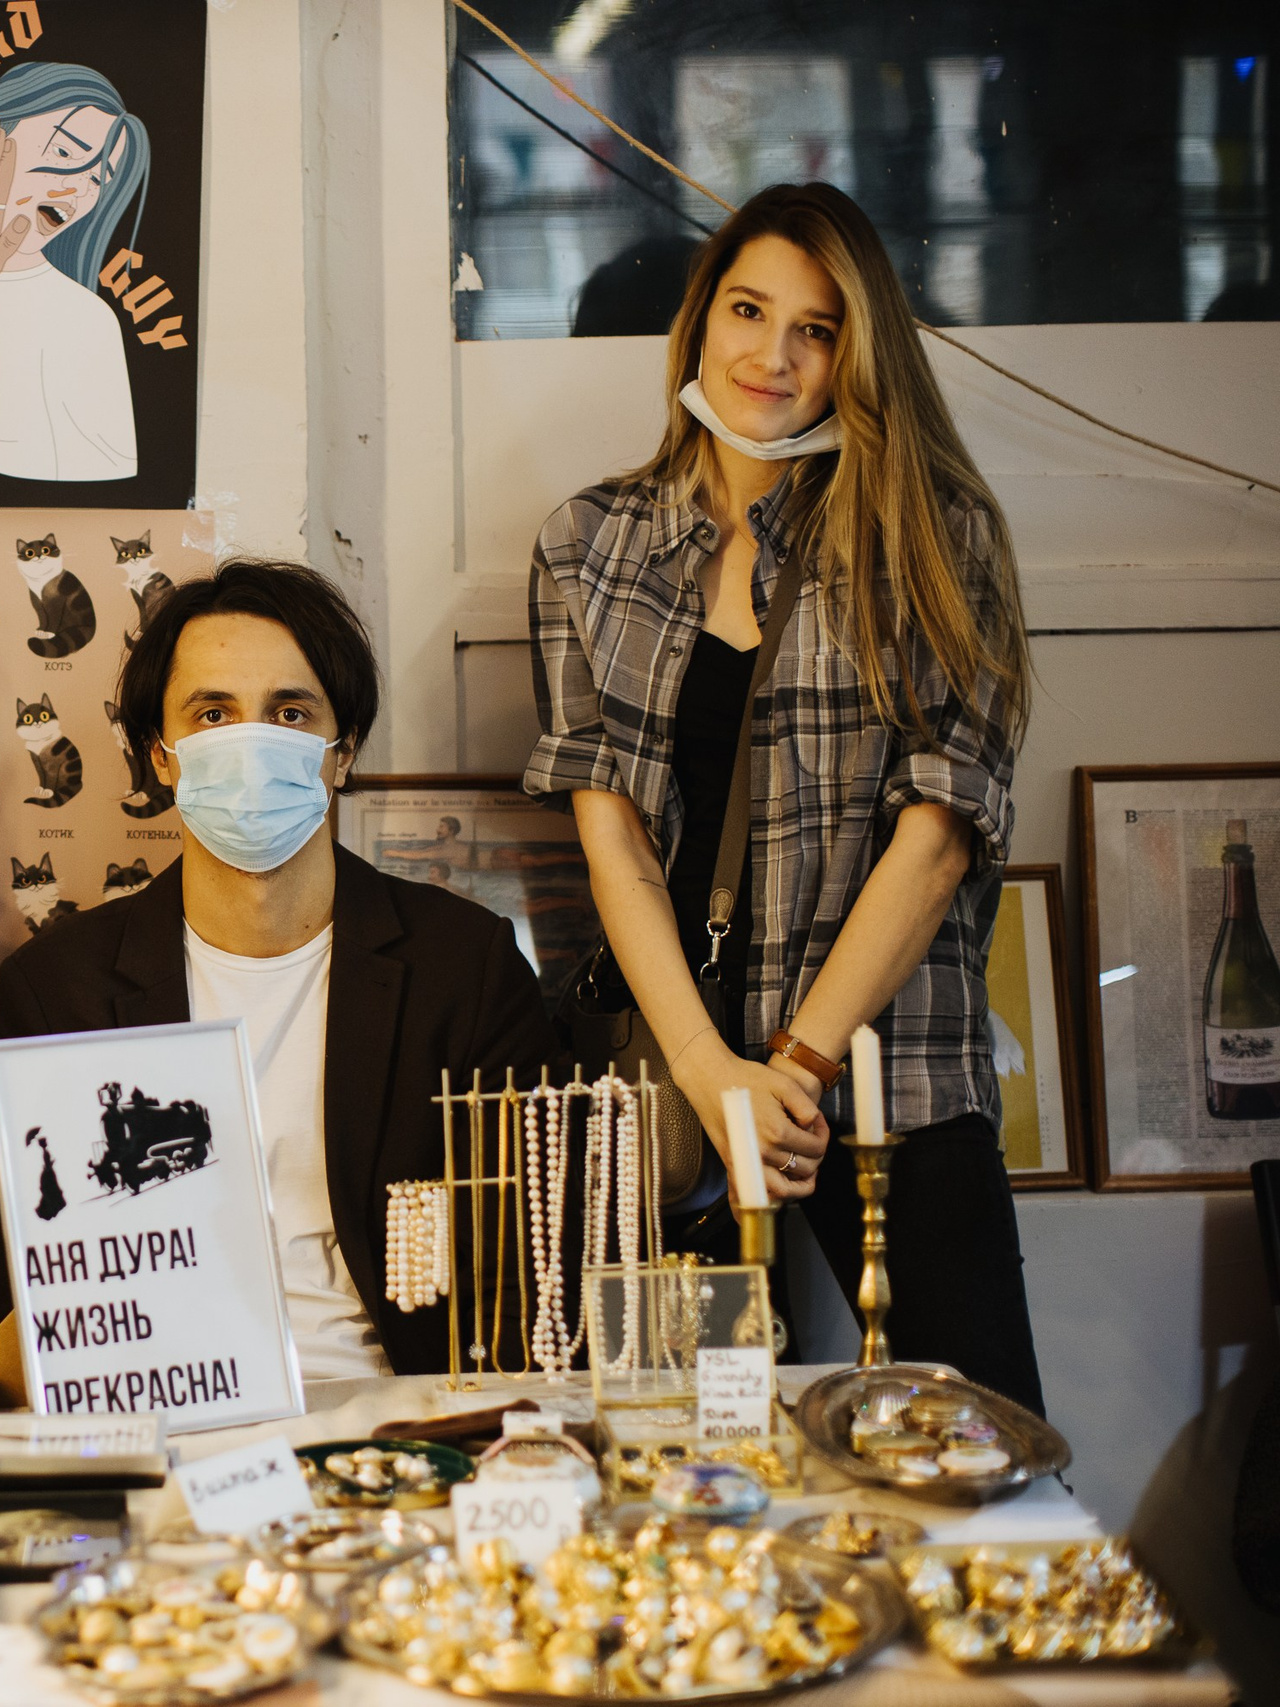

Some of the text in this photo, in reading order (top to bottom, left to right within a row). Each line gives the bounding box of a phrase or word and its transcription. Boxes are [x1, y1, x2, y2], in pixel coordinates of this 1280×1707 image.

[98, 247, 189, 350] GUY
[44, 661, 73, 672] КОТЭ
[38, 829, 74, 839] КОТИК
[126, 829, 182, 841] КОТЕНЬКА
[26, 1226, 199, 1287] АНЯ ДУРА!
[32, 1299, 153, 1353] ЖИЗНЬ
[44, 1357, 241, 1415] ПРЕКРАСНА!
[465, 1495, 551, 1533] 2500
